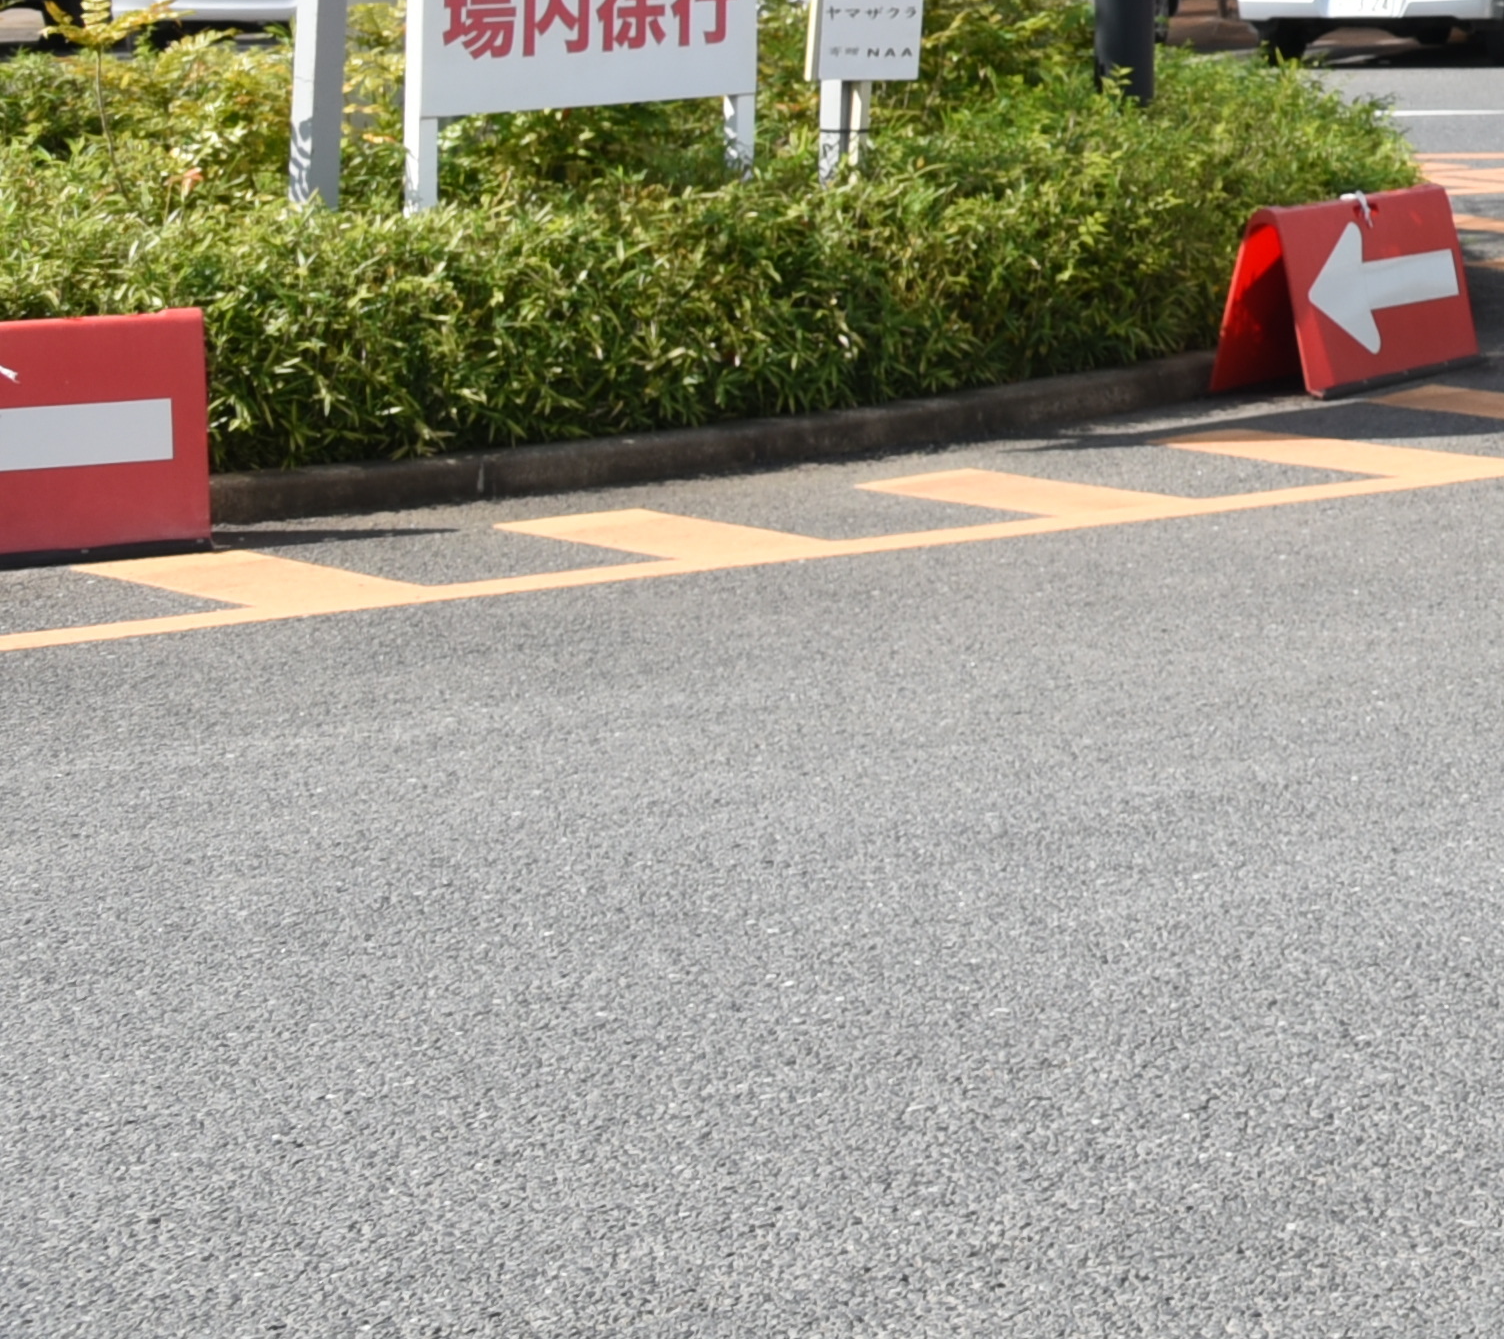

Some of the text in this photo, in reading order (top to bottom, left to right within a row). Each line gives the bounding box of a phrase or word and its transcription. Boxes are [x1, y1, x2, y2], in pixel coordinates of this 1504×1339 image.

[826, 5, 918, 20] ヤマザクラ
[866, 47, 913, 58] NAA
